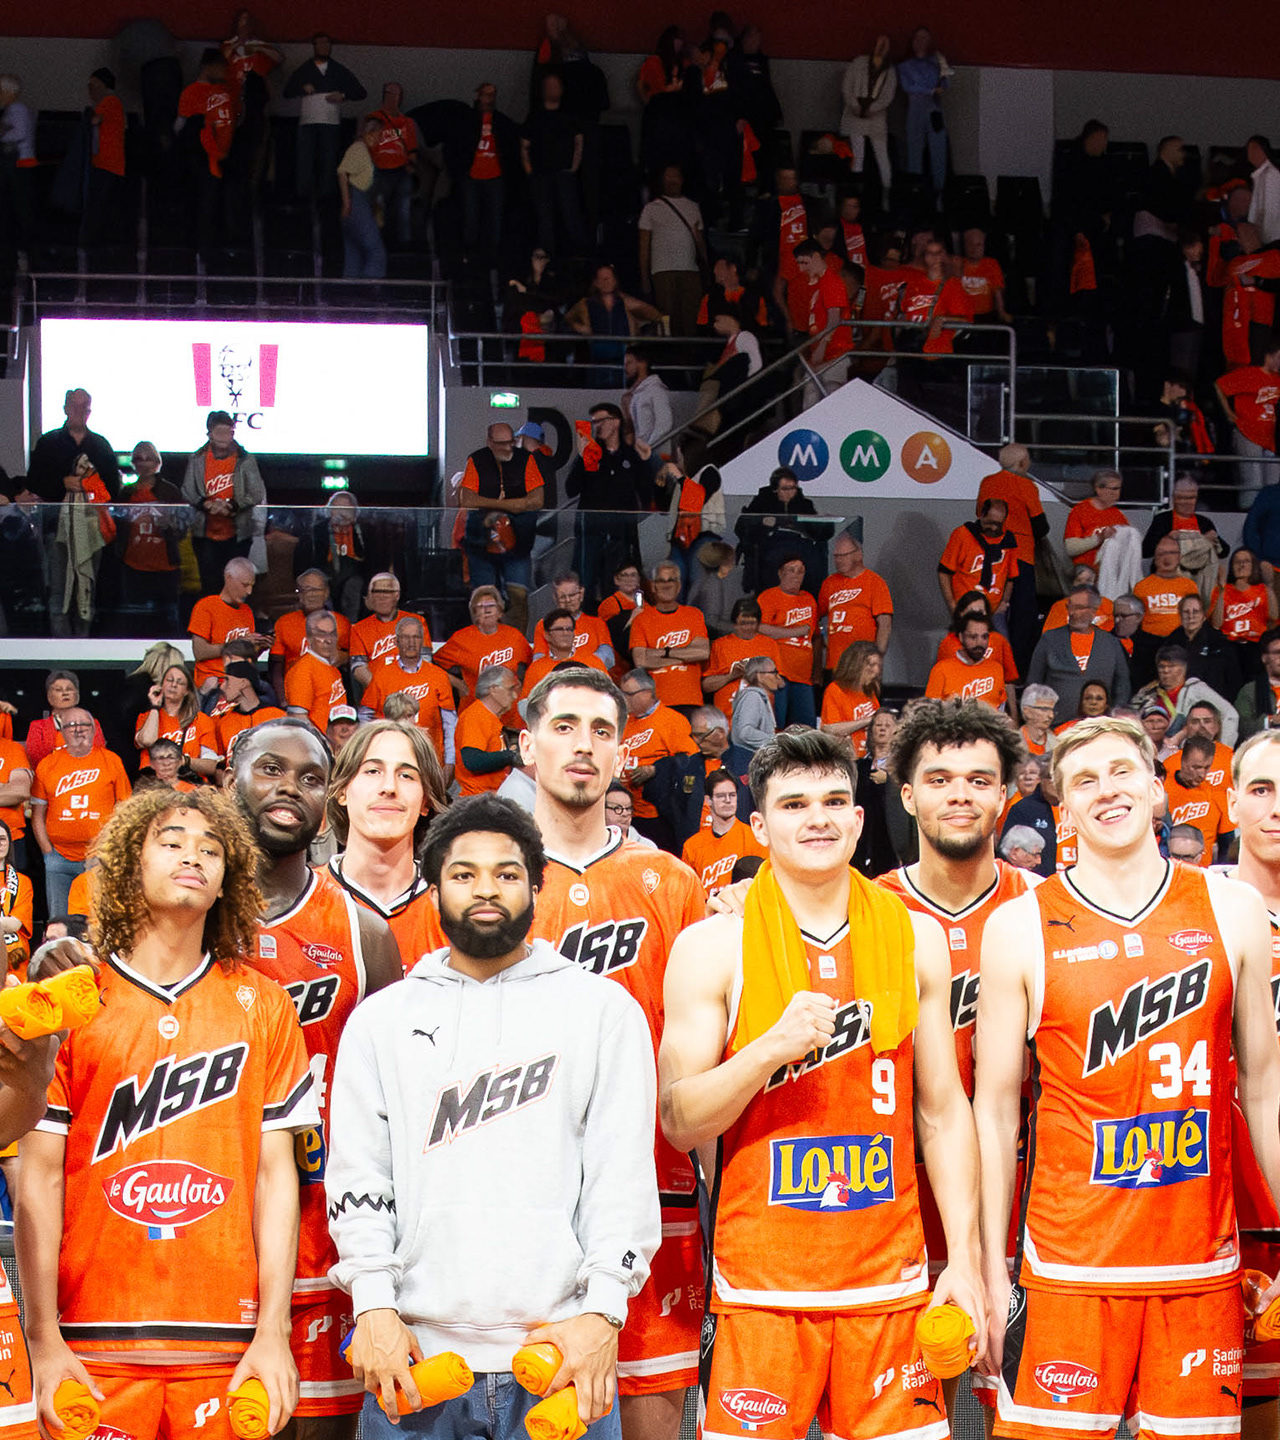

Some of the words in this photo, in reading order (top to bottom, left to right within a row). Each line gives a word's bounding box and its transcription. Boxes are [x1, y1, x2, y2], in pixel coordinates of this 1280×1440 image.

[1147, 594, 1177, 608] MSB
[785, 606, 812, 626] MSB
[656, 629, 690, 650] MSB
[962, 677, 994, 701] MSB
[55, 768, 100, 797] MSB
[1172, 802, 1210, 827] MSB
[309, 944, 343, 961] Gaulois
[1175, 930, 1214, 947] Gaulois
[1082, 957, 1214, 1079] MSB
[1148, 1039, 1211, 1100] 34
[871, 1057, 897, 1116] 9
[92, 1041, 249, 1164] MSB
[426, 1053, 561, 1151] MSB
[1101, 1106, 1204, 1178] Loué
[777, 1132, 890, 1196] Loué
[109, 1180, 121, 1197] le
[121, 1171, 227, 1207] Gaulois
[1040, 1364, 1099, 1393] Gaulois
[722, 1389, 732, 1405] le
[728, 1391, 788, 1418] Gaulois
